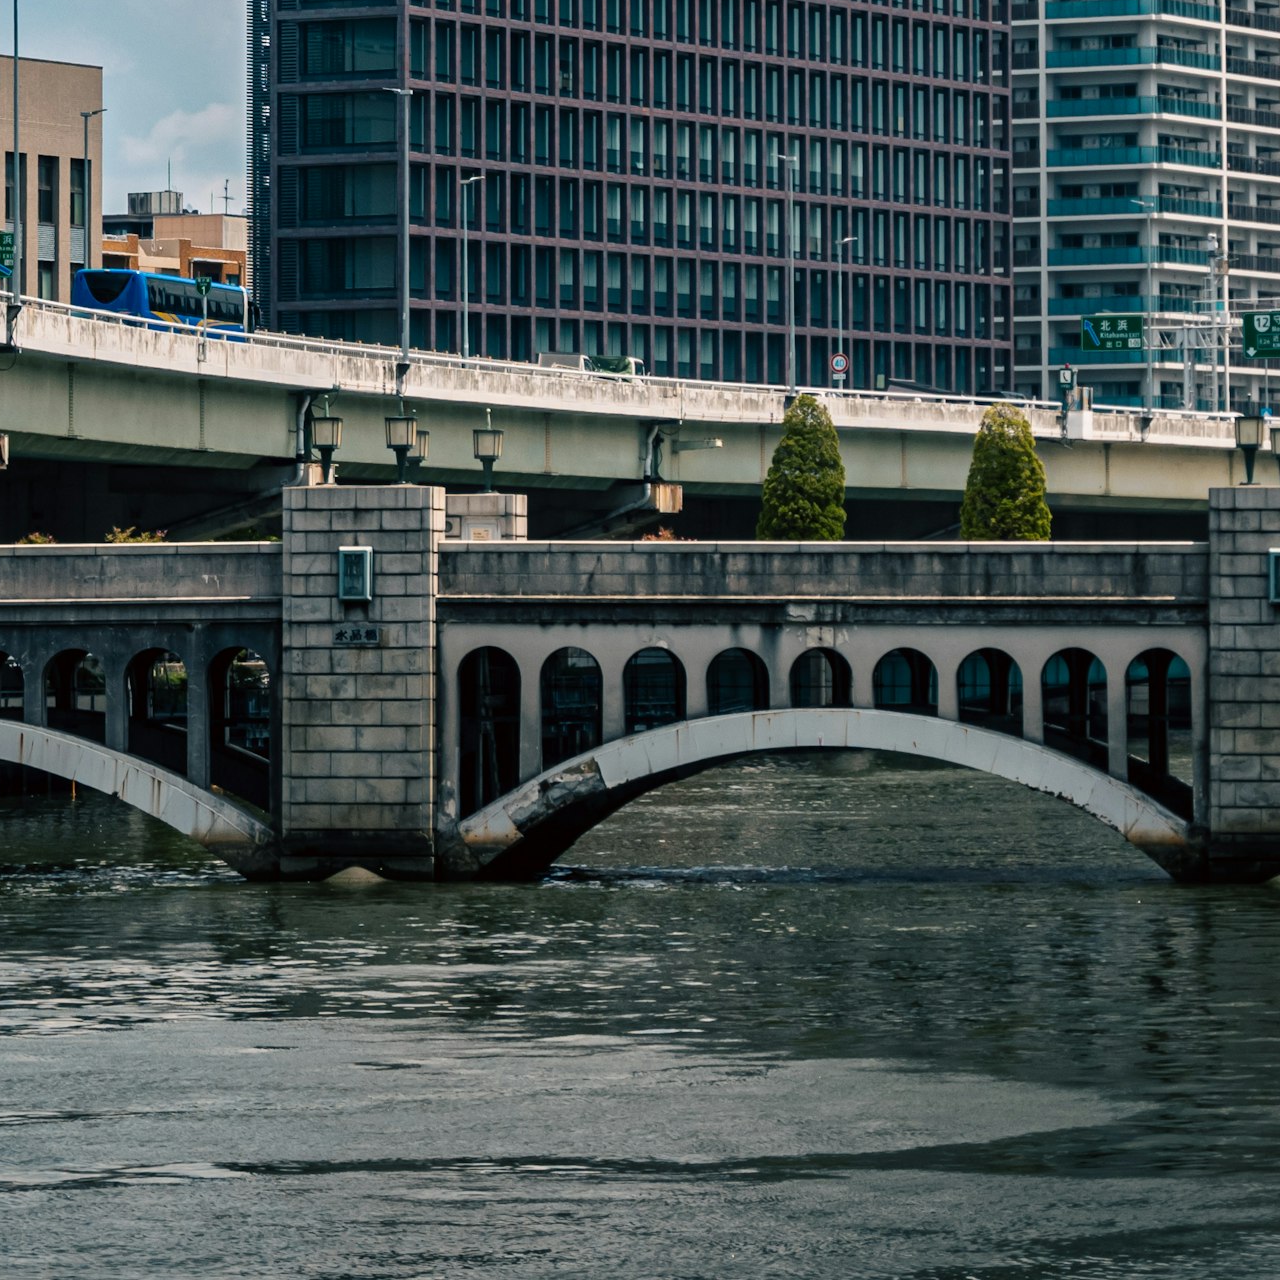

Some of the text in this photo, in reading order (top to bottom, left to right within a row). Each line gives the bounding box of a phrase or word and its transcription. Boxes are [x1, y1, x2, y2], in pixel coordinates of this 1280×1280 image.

[1100, 320, 1128, 331] 北浜
[1256, 317, 1269, 328] 12
[1106, 340, 1122, 348] 出口
